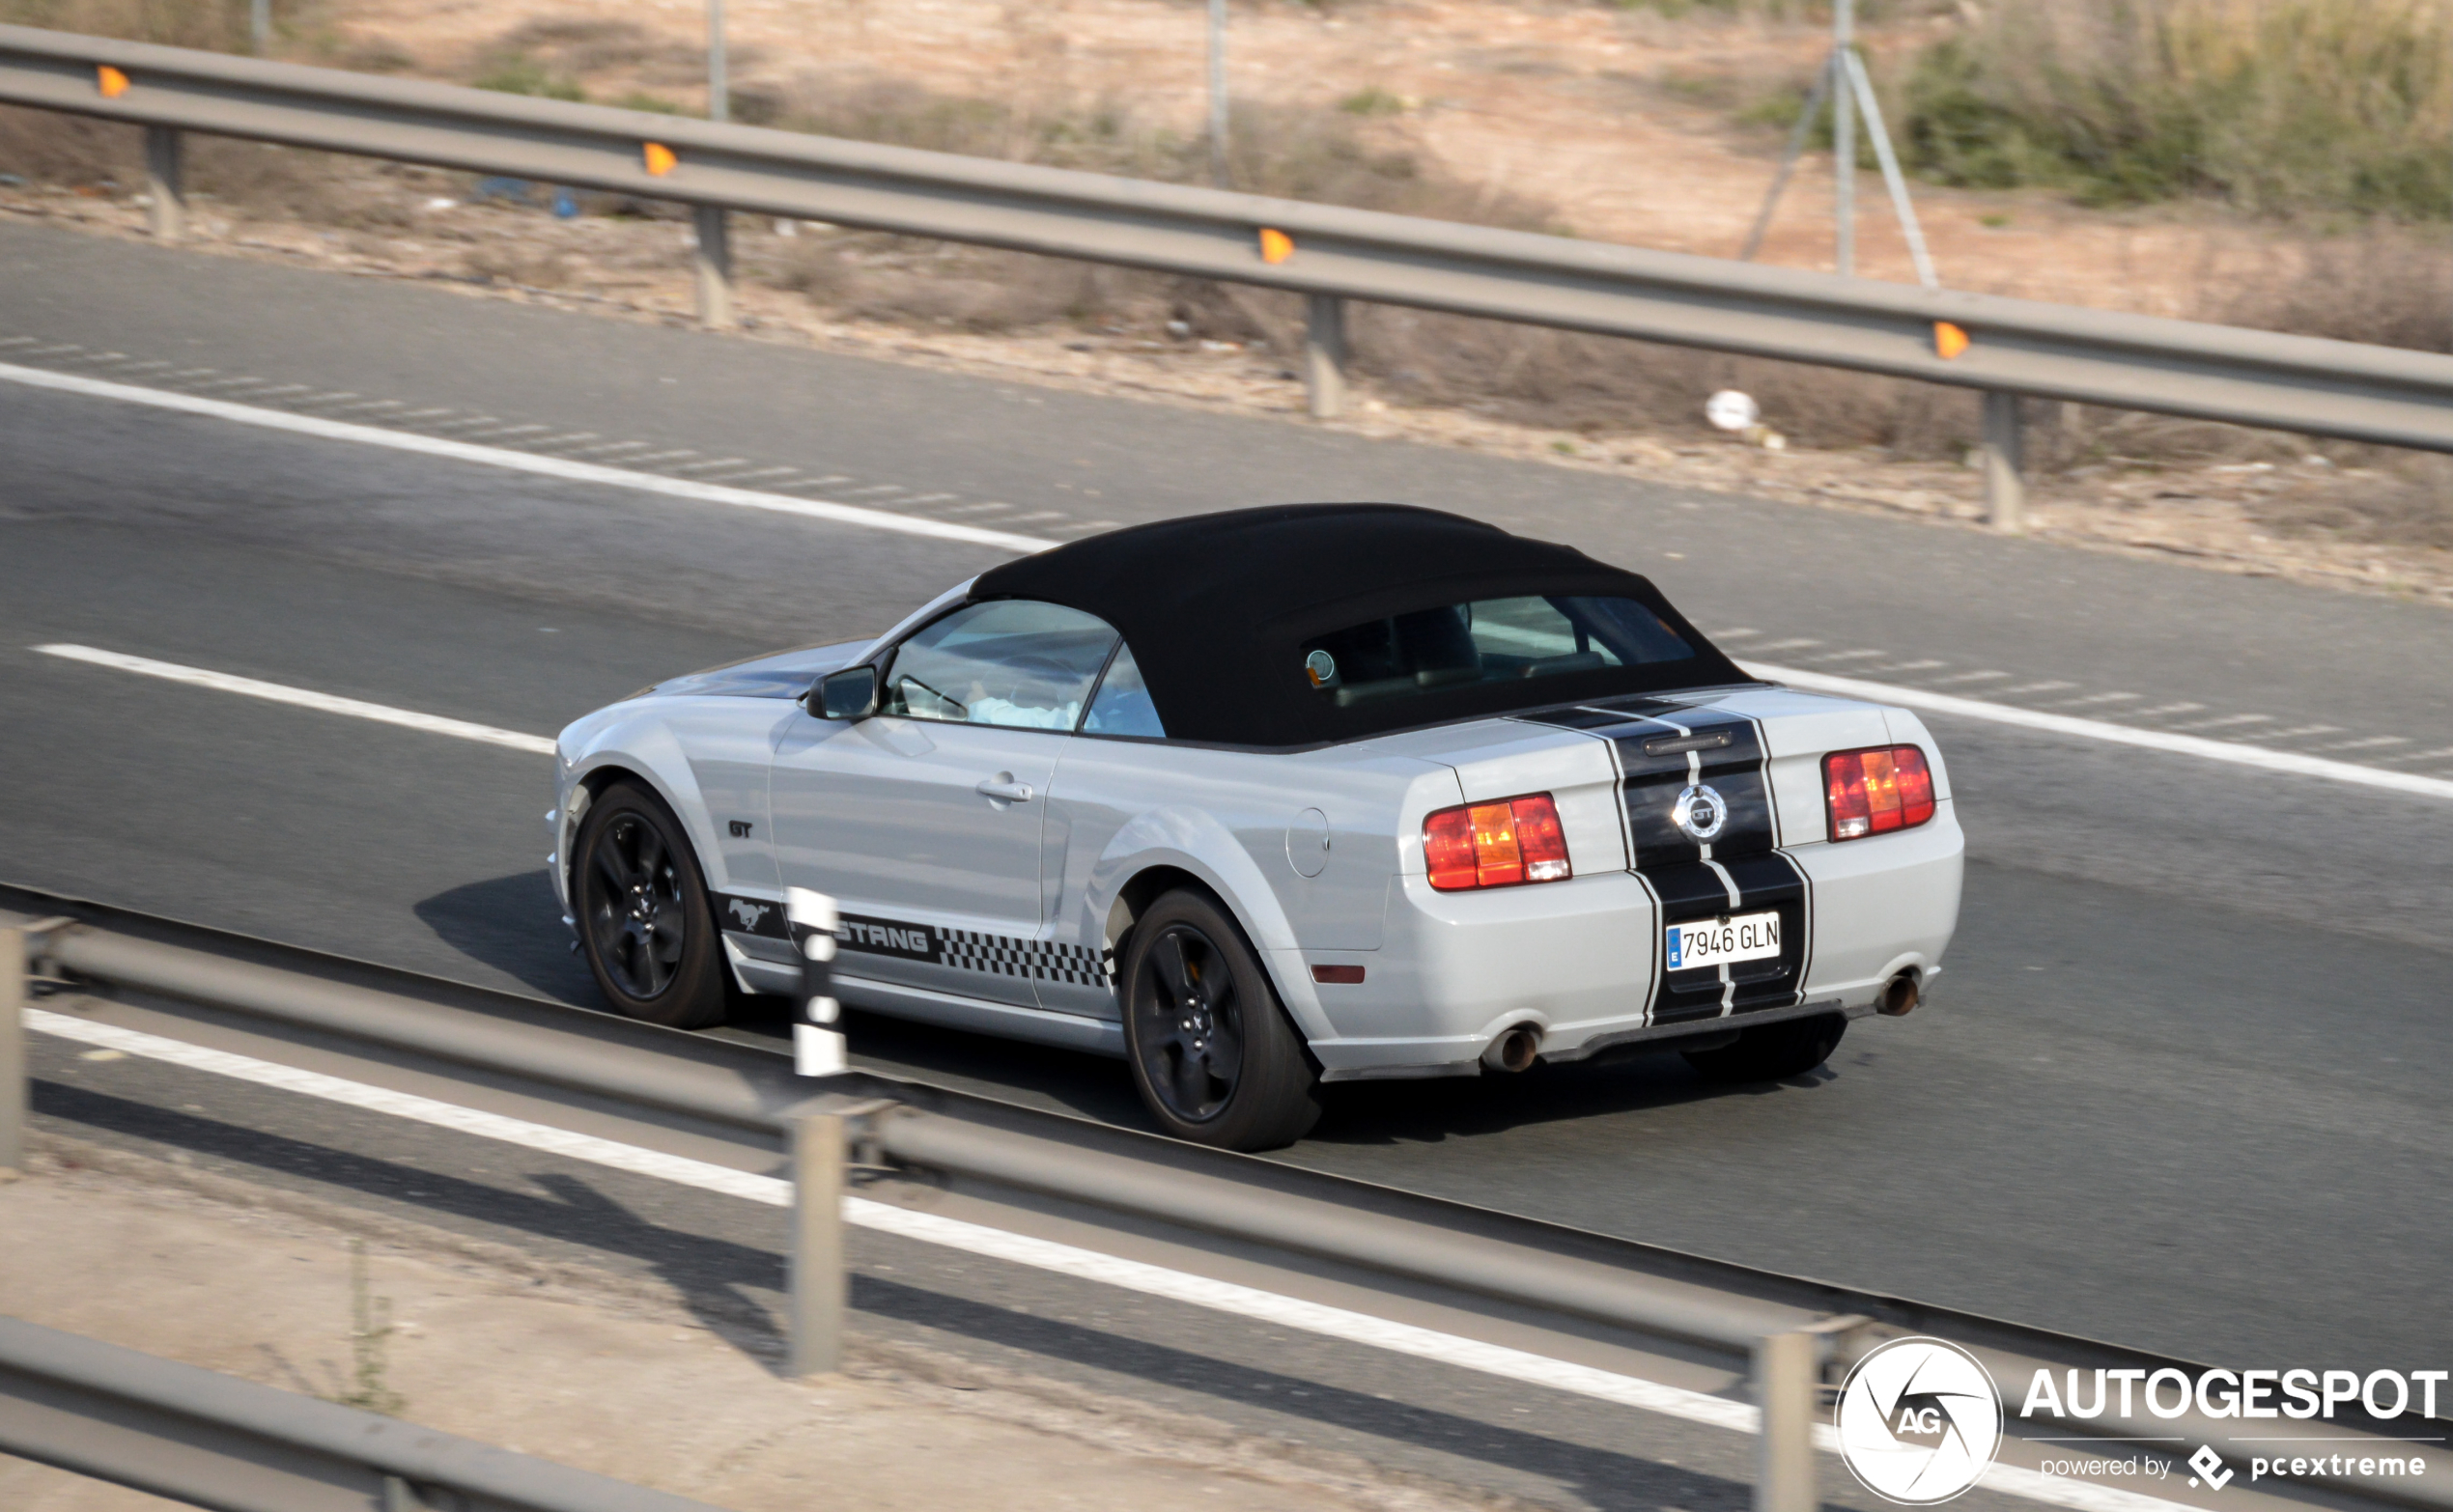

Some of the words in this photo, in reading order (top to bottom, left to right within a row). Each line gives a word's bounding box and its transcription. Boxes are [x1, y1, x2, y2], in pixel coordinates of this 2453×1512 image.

[1691, 807, 1713, 821] GT
[729, 820, 752, 838] GT
[789, 917, 928, 953] STANG
[1683, 927, 1734, 959] 7946
[1740, 920, 1778, 950] GLN
[1671, 952, 1678, 963] E
